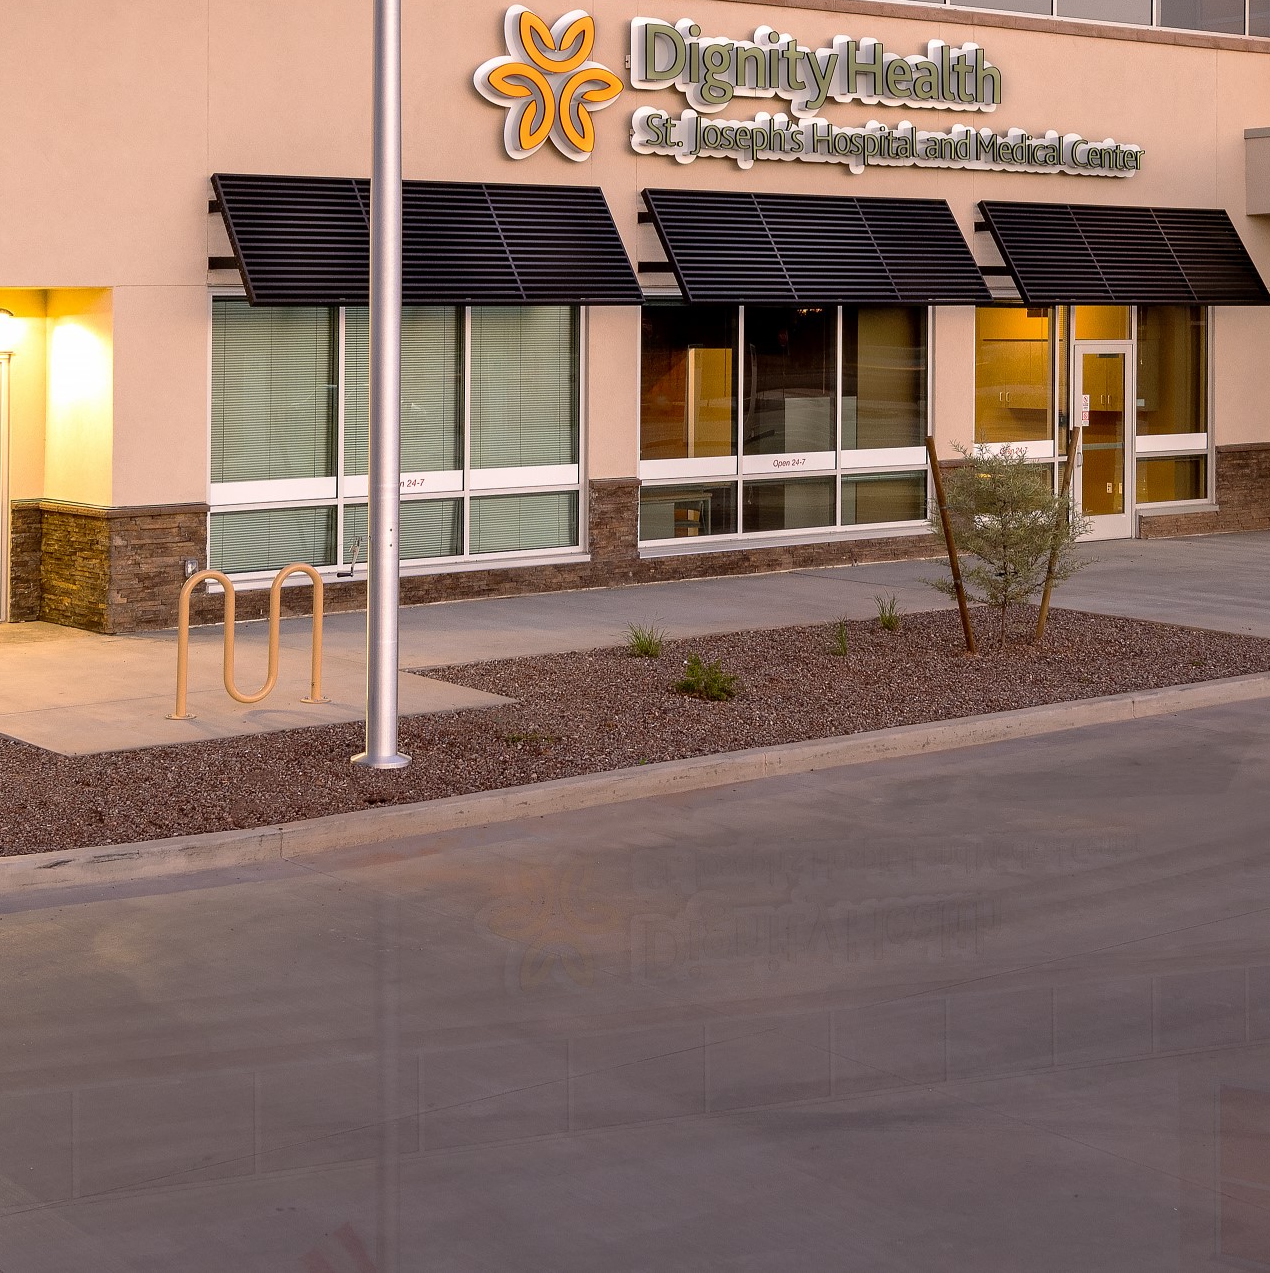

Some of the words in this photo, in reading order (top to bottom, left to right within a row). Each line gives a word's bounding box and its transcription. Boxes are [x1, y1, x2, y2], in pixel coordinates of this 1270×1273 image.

[644, 23, 839, 110] Dignity
[847, 40, 1002, 105] Health
[646, 113, 684, 148] St.
[812, 123, 918, 165] Hospital
[925, 130, 970, 161] and
[976, 132, 1066, 165] Medical
[1071, 139, 1146, 171] Center
[772, 458, 791, 468] Open
[791, 458, 806, 466] 24-7
[406, 478, 425, 487] 24-7
